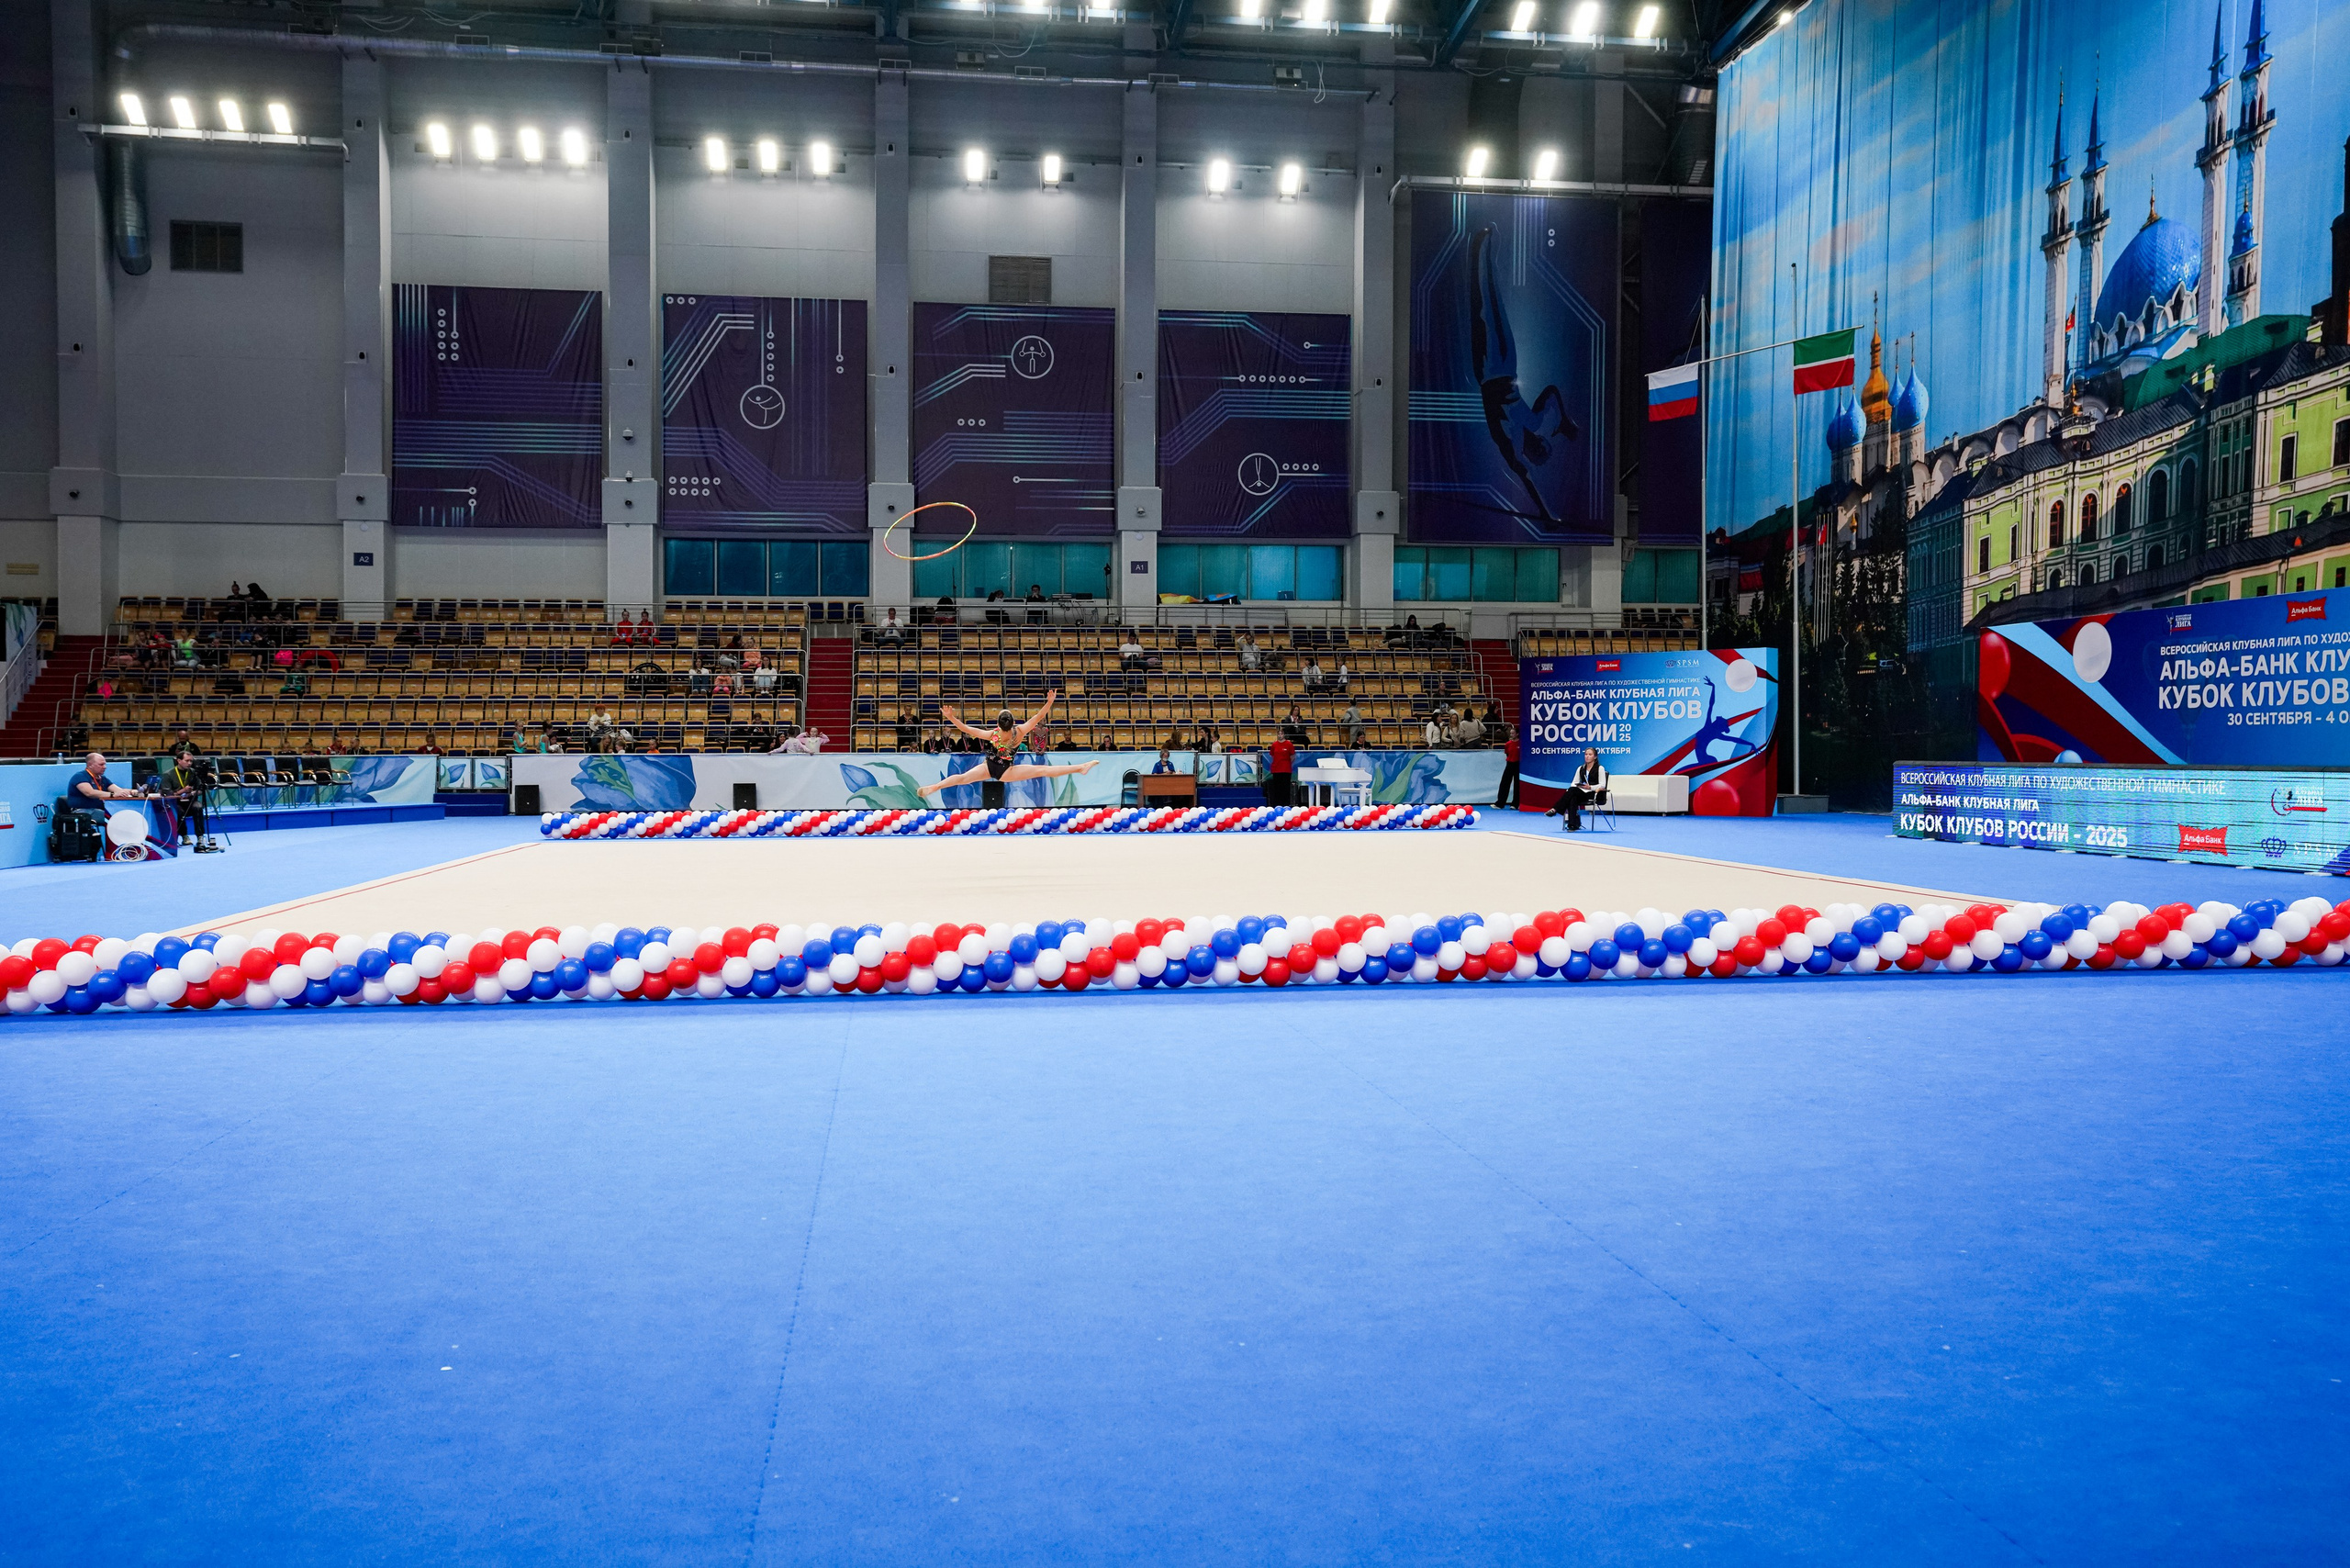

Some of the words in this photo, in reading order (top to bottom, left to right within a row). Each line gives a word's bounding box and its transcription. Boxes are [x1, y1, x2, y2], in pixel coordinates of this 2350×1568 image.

[2291, 607, 2308, 615] Альфа
[2175, 620, 2192, 628] ЛИГА
[2160, 642, 2231, 656] ВСЕРОССИЙСКАЯ
[2232, 638, 2276, 651] КЛУБНАЯ
[2277, 635, 2302, 647] ЛИГА
[2303, 634, 2319, 645] ПО
[2321, 632, 2350, 644] ХУДО
[2160, 652, 2299, 680] АЛЬФА-БАНК
[1617, 678, 1666, 686] ХУДОЖЕСТВЕННОЙ
[1531, 689, 1606, 700] АЛЬФА-БАНК
[1609, 688, 1665, 699] КЛУБНАЯ
[1668, 686, 1701, 697] ЛИГА
[2159, 683, 2234, 710] КУБОК
[2242, 678, 2349, 707] КЛУБОВ
[1530, 702, 1602, 722] КУБОК
[1608, 700, 1702, 720] КЛУБОВ
[2227, 713, 2243, 725] 30
[2245, 711, 2312, 725] СЕНТЯБРЯ
[2325, 711, 2335, 723] 4
[1530, 723, 1617, 742] РОССИИ
[1618, 723, 1632, 732] 20
[1618, 733, 1631, 742] 25
[1900, 771, 1966, 786] ВСЕРОССИЙСКАЯ
[1967, 773, 2007, 788] КЛУБНАЯ
[2009, 774, 2031, 789] ЛИГА
[2032, 776, 2048, 790] ПО
[2049, 776, 2145, 792] ХУДОЖЕСТВЕННОЙ
[2148, 778, 2227, 795] ГИМНАСТИКЕ
[1901, 794, 1962, 808] АЛЬФА-БАНК
[1963, 796, 2010, 811] КЛУБНАЯ
[2013, 799, 2040, 812] ЛИГА
[2295, 796, 2323, 806] ЛИГА
[1900, 813, 1943, 833] КУБОК
[1947, 816, 2005, 837] КЛУБОВ
[2009, 819, 2069, 843] РОССИИ
[2086, 824, 2128, 847] 2025
[2183, 834, 2205, 845] Альфа
[2205, 834, 2222, 844] Банк
[2293, 842, 2338, 858] SPSM
